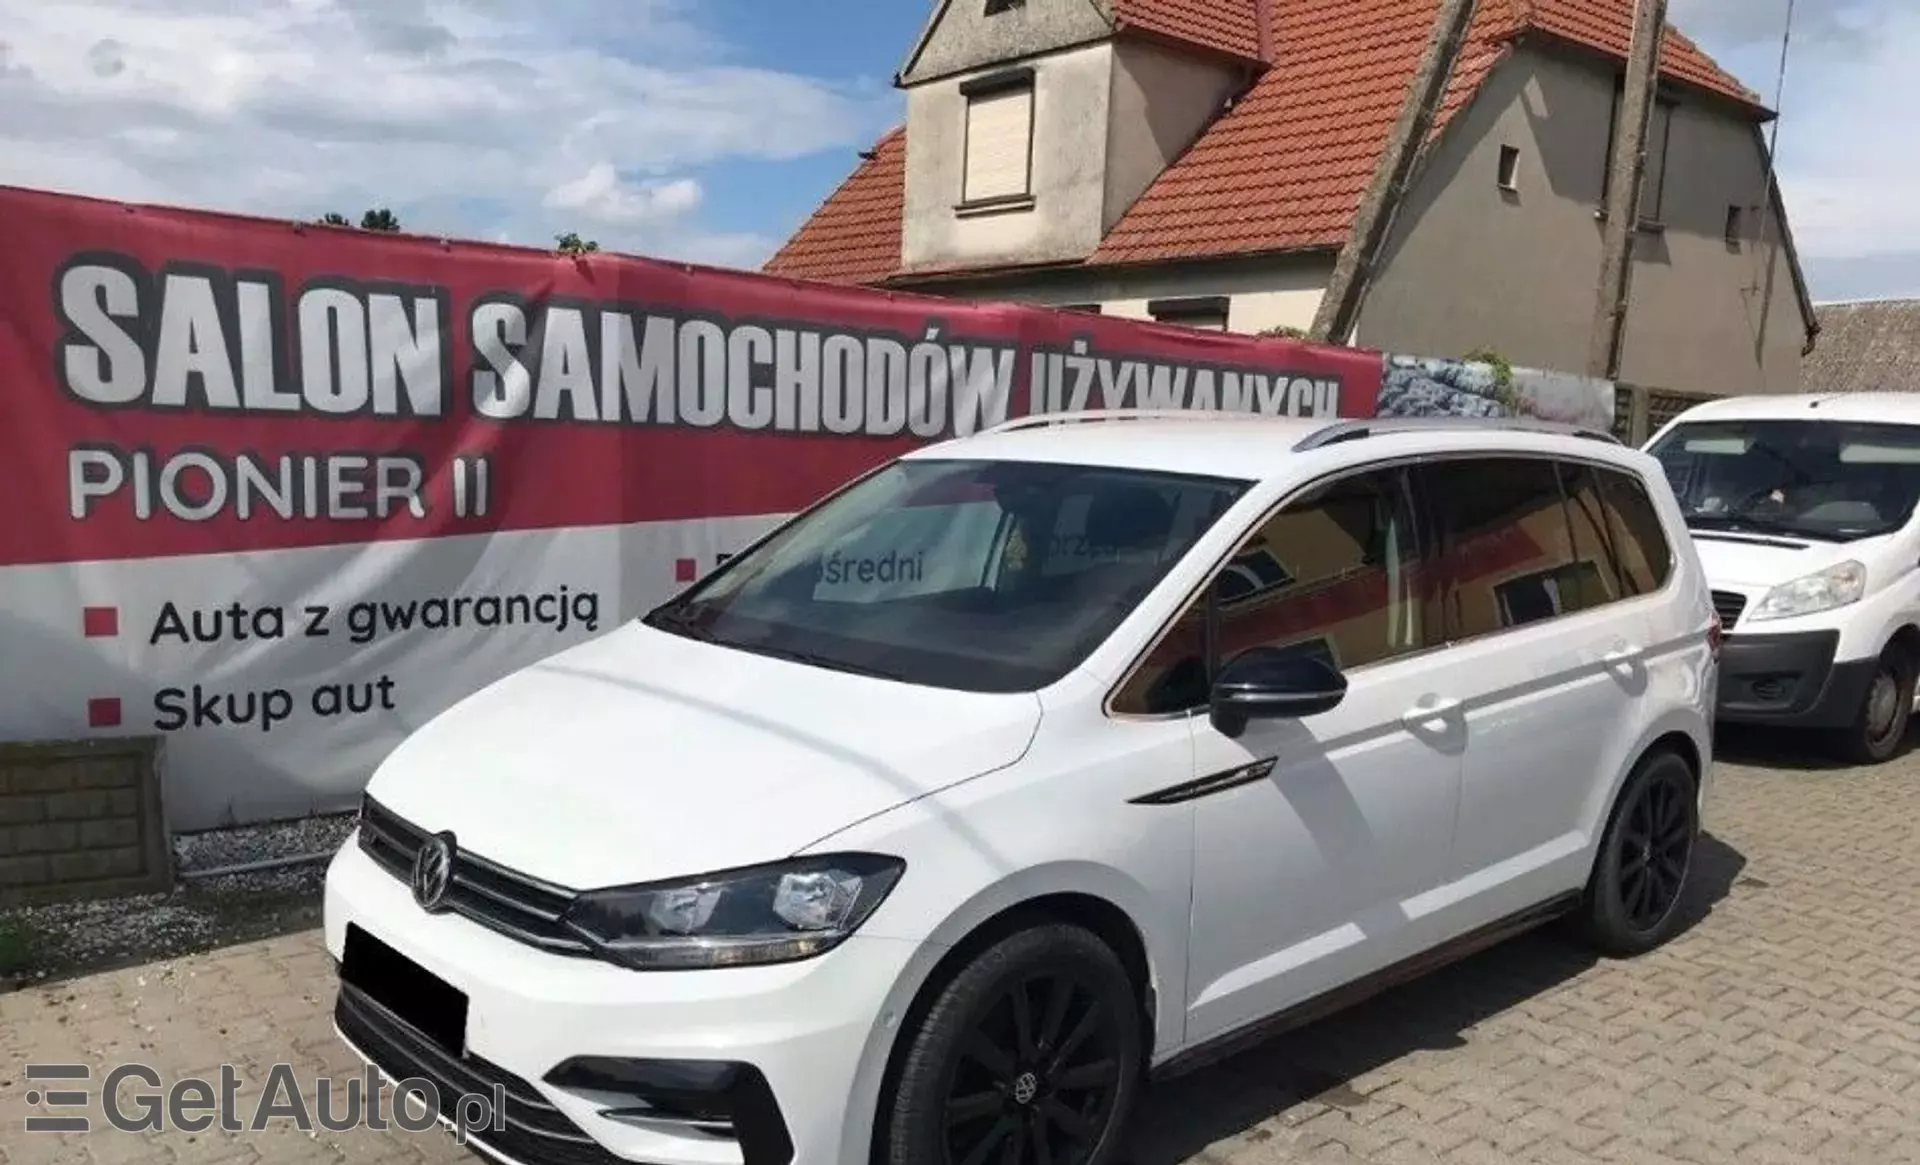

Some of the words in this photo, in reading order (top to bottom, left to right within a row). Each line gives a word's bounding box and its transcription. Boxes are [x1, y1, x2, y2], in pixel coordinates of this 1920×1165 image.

[60, 264, 442, 416] SALON
[472, 302, 1016, 438] SAMOCHODÓW
[69, 449, 425, 521] PIONIER
[453, 456, 489, 518] II
[150, 601, 285, 645] Auta
[304, 606, 330, 637] z
[348, 586, 600, 646] gwarancją
[153, 687, 294, 731] Skup
[311, 675, 396, 717] aut
